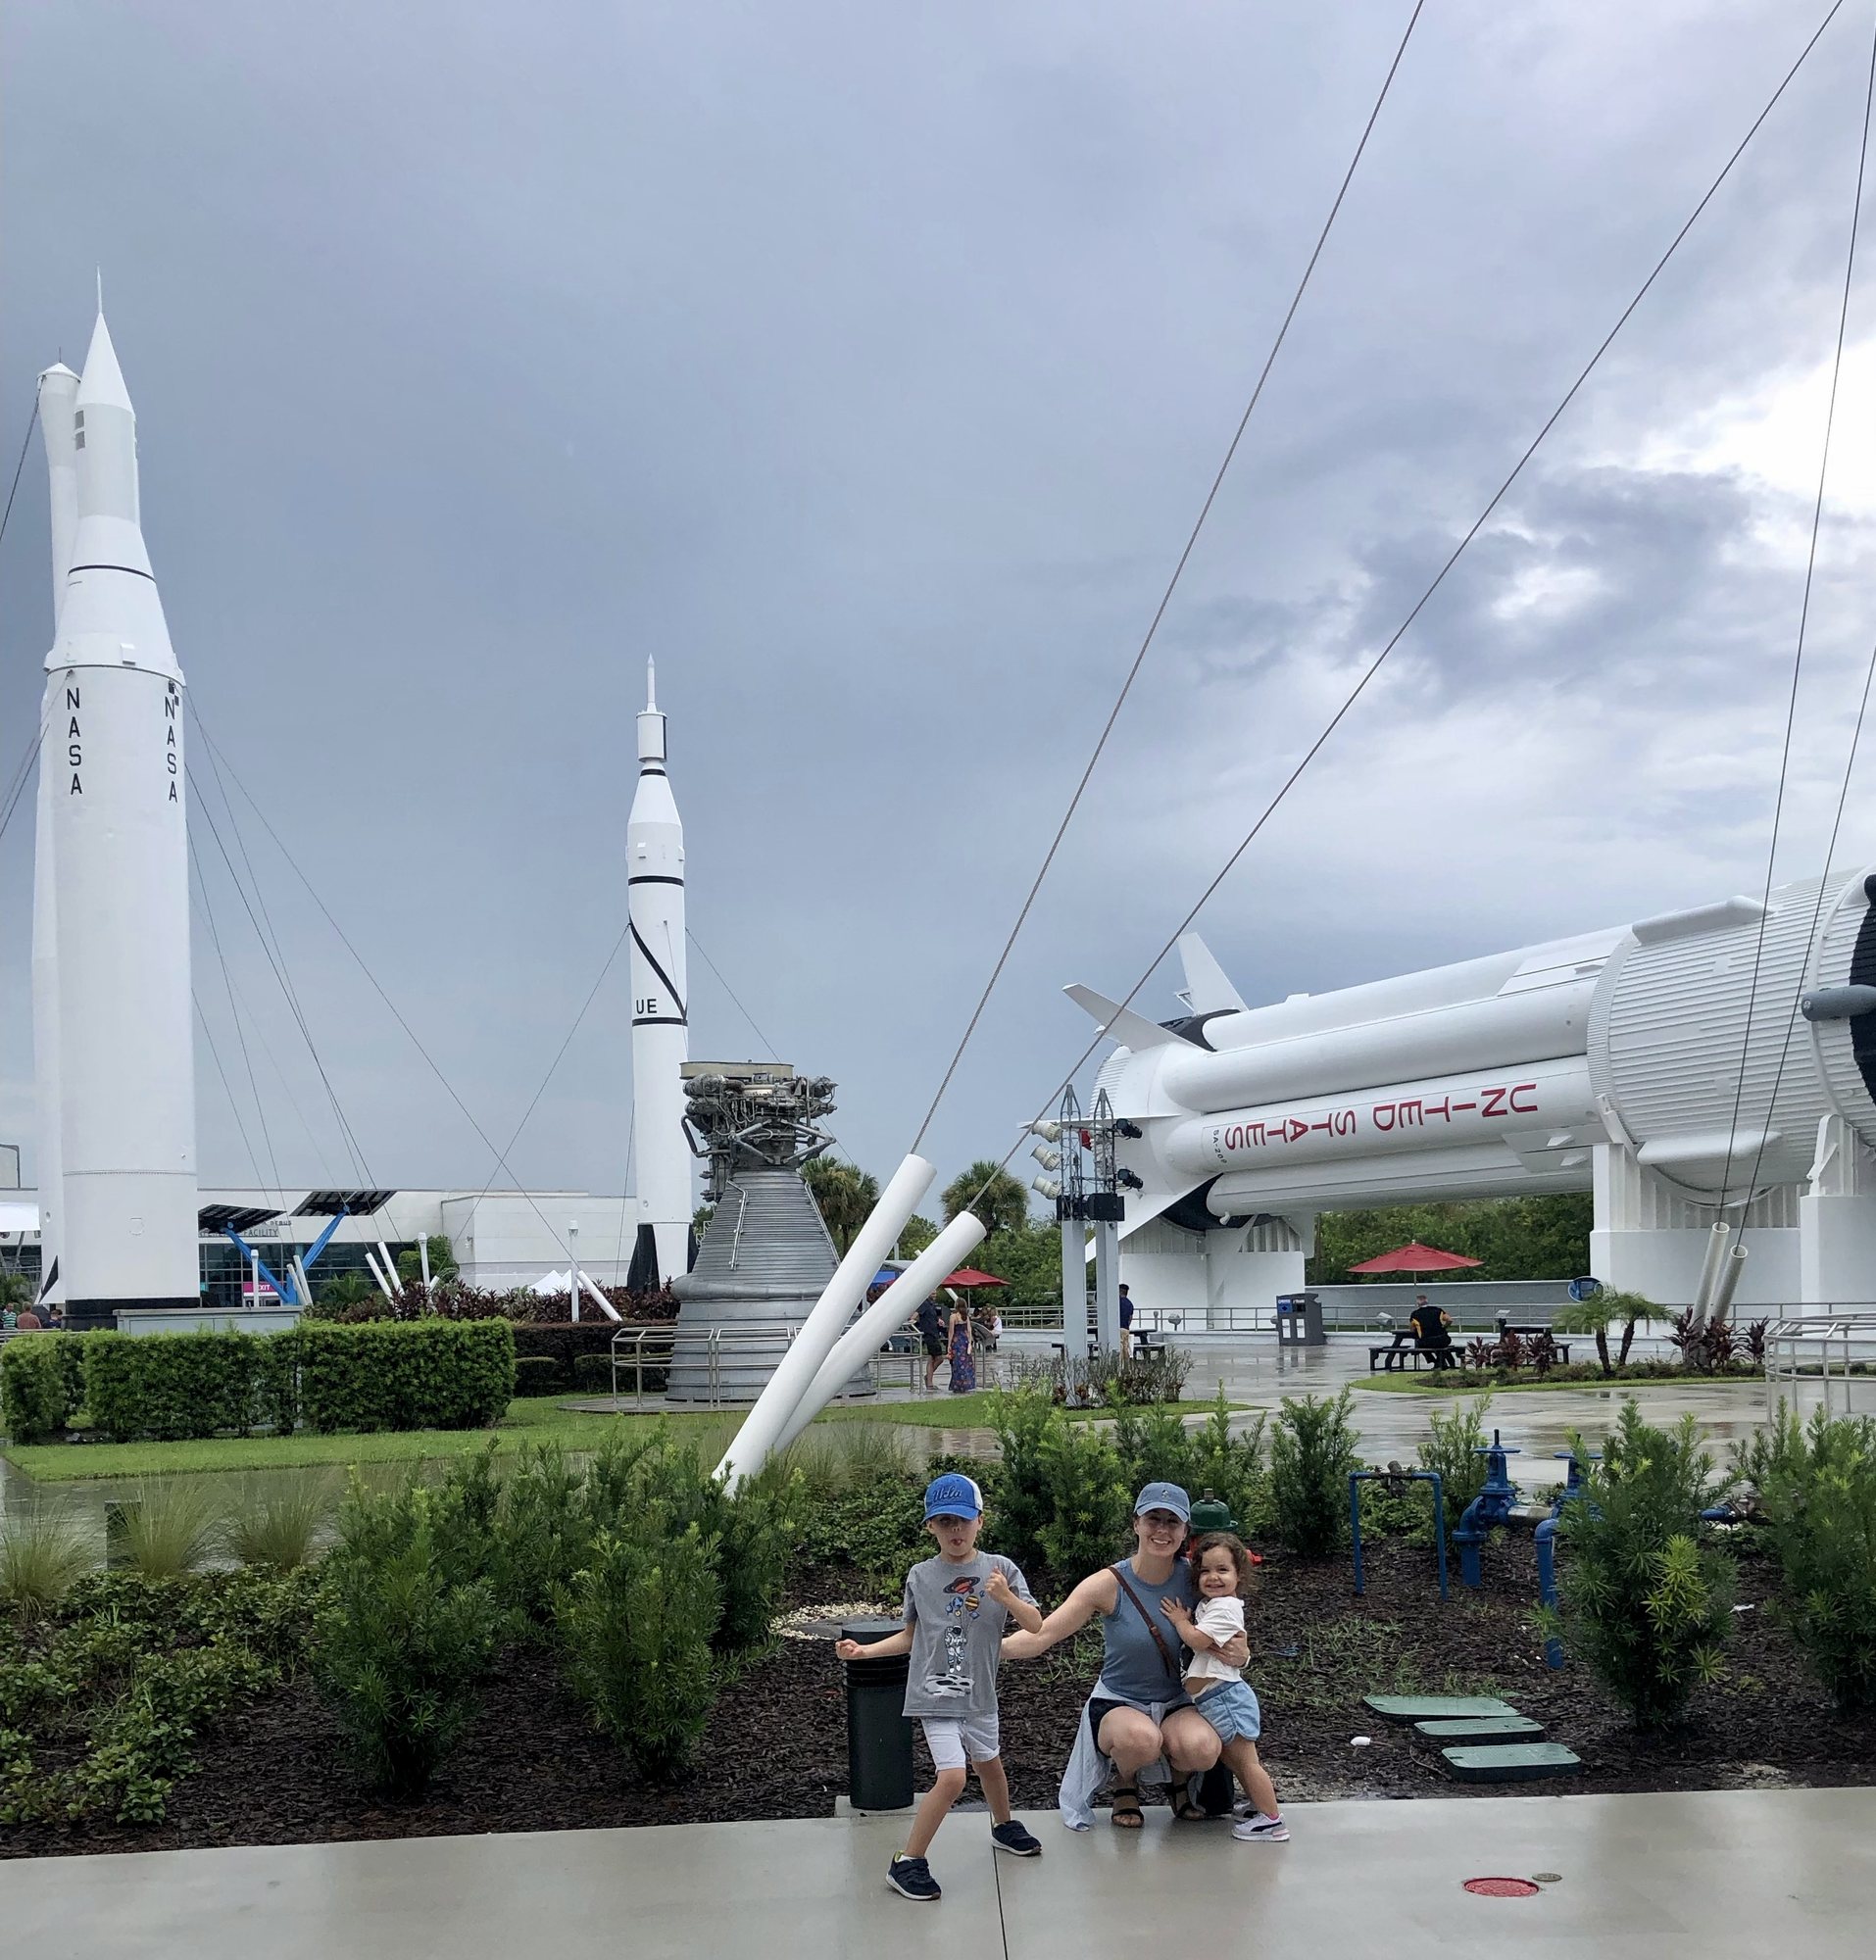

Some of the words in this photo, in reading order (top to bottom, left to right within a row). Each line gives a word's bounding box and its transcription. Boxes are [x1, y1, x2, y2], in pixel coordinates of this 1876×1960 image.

[67, 687, 82, 795] NASA
[165, 696, 178, 803] NASA
[636, 998, 658, 1014] UE
[1225, 1110, 1357, 1151] STATES
[1373, 1083, 1539, 1131] UNITED
